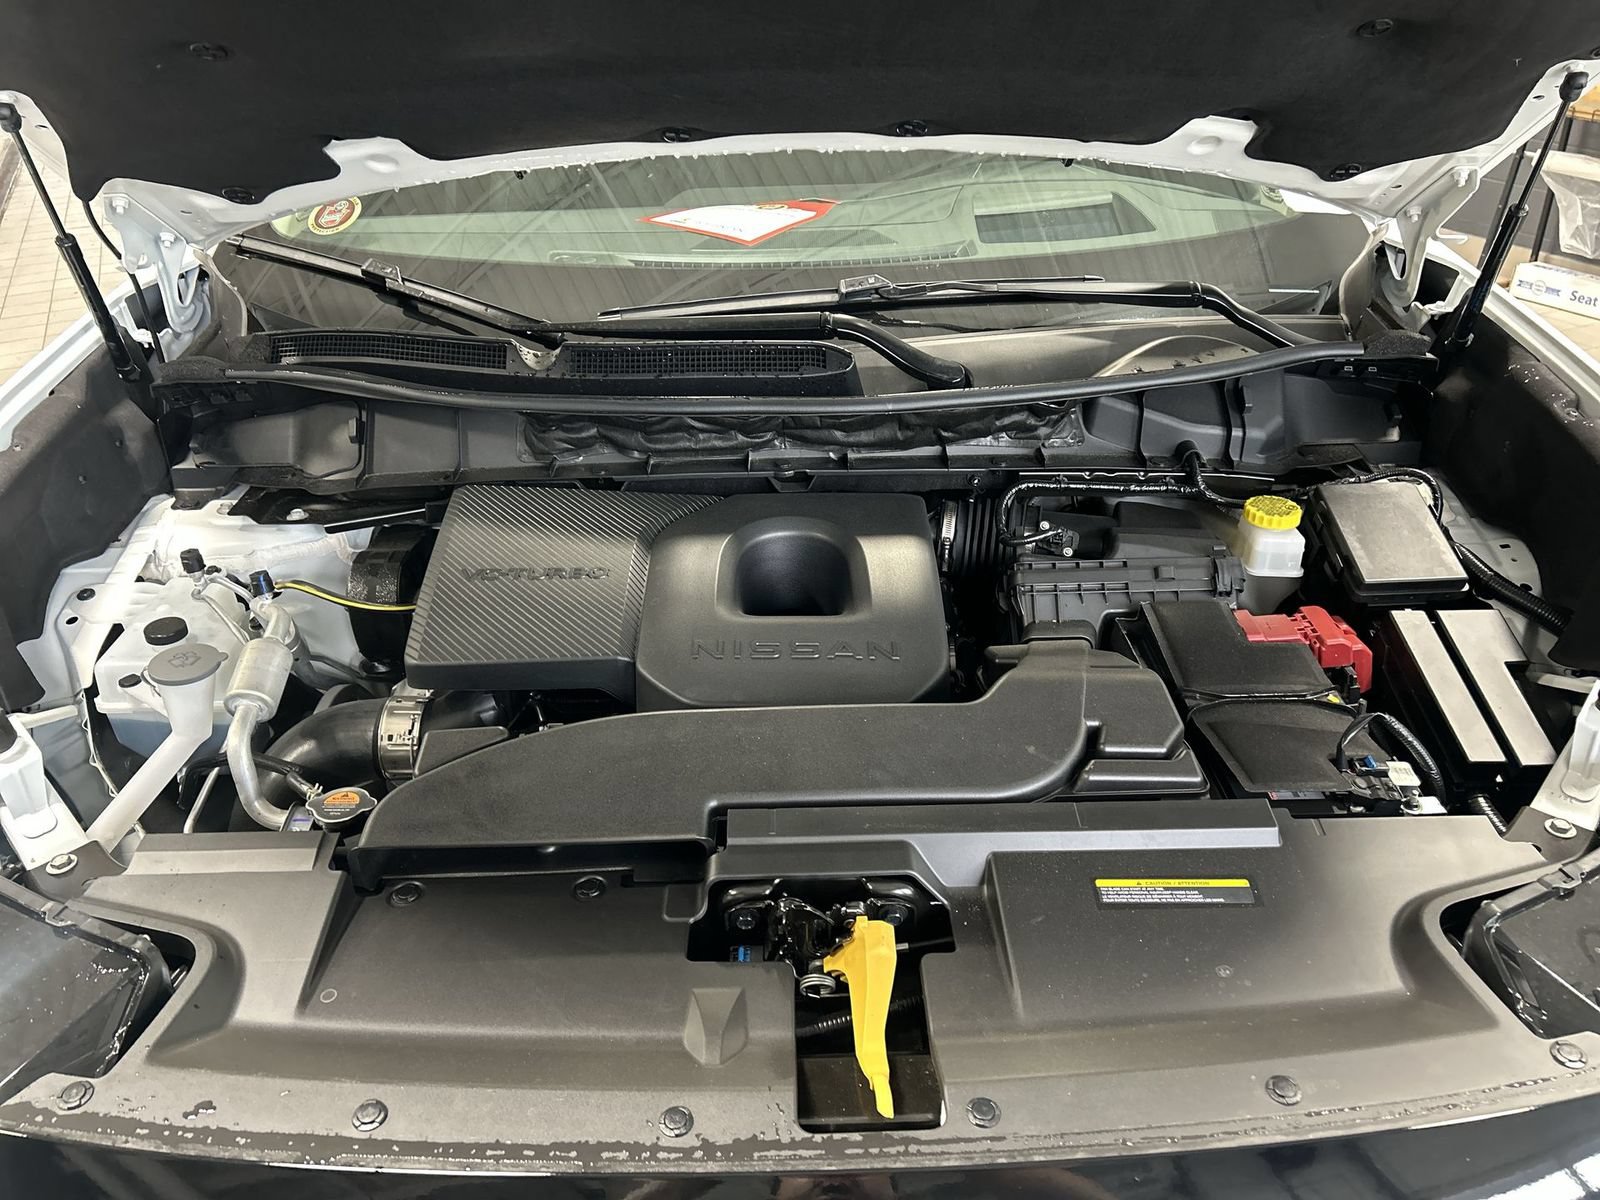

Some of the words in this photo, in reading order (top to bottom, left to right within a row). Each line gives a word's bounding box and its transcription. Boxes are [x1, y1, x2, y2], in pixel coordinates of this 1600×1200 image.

[1569, 290, 1598, 307] Seat
[462, 567, 609, 581] VC-TURBO
[691, 640, 900, 660] NISSAN
